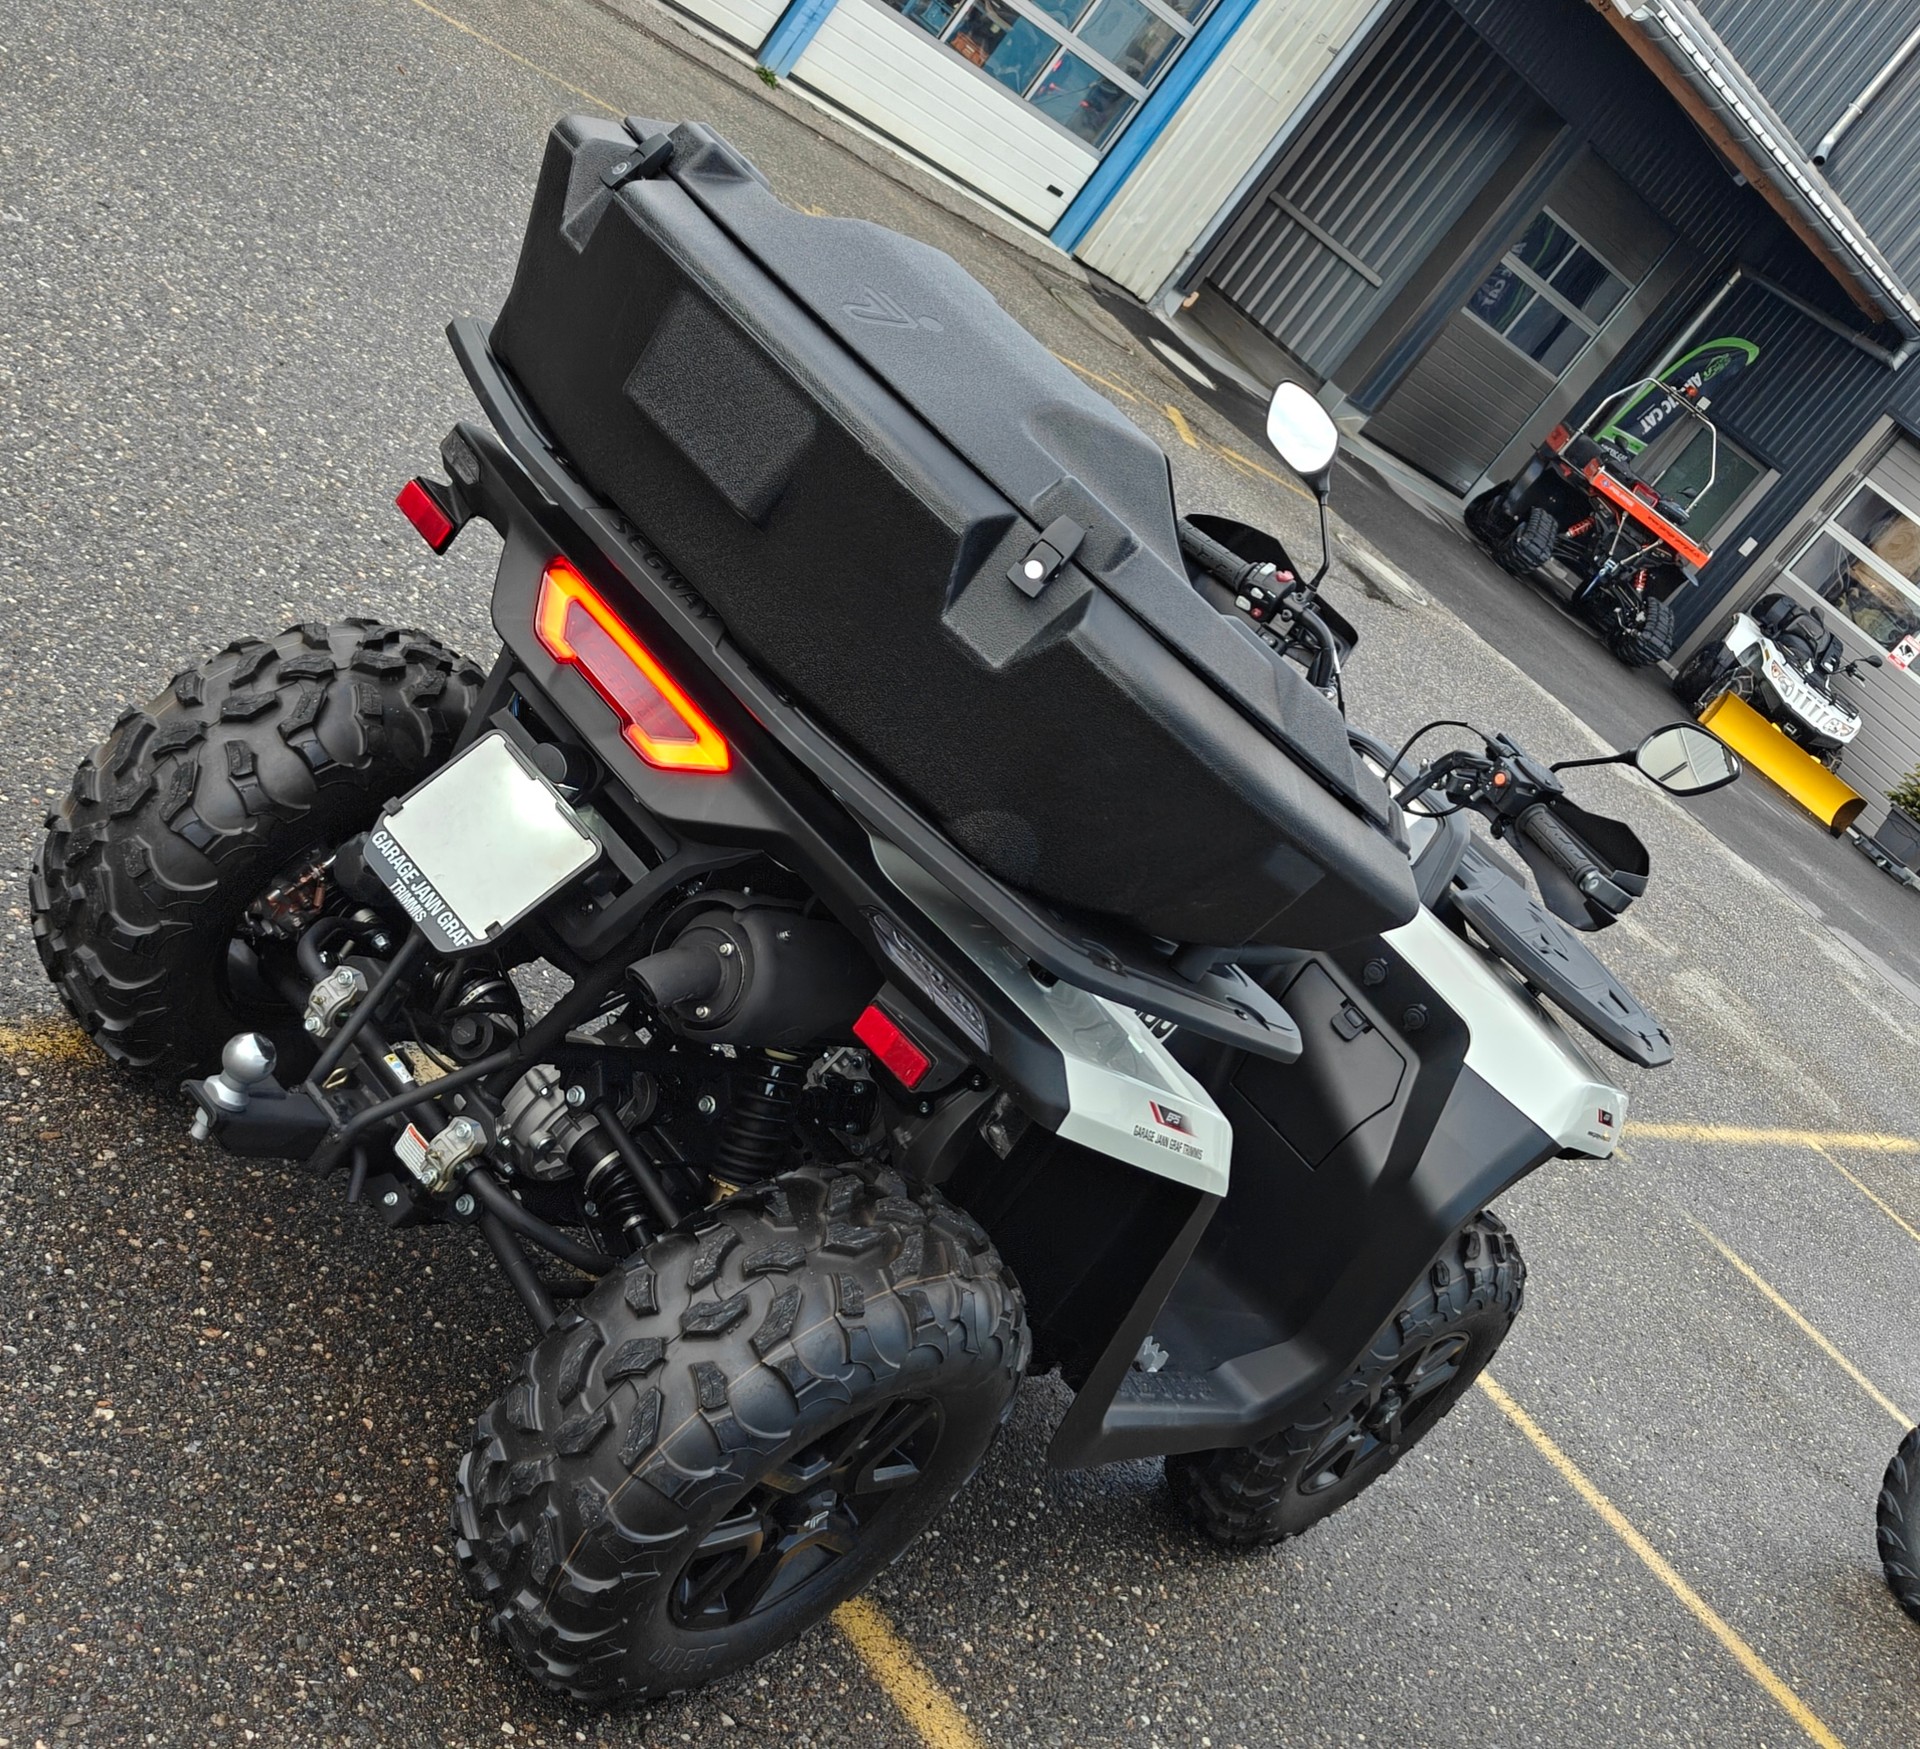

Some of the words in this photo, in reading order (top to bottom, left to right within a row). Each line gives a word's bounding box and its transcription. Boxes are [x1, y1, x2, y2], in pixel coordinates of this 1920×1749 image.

[1640, 408, 1663, 433] CAT
[609, 515, 720, 620] SEGWAY
[372, 831, 420, 885] GARAGE
[411, 881, 446, 916] JANN
[437, 911, 473, 947] GRAF
[389, 878, 427, 922] TRIMMIS
[1133, 1125, 1155, 1142] GARAGE
[1166, 1112, 1181, 1125] EPS
